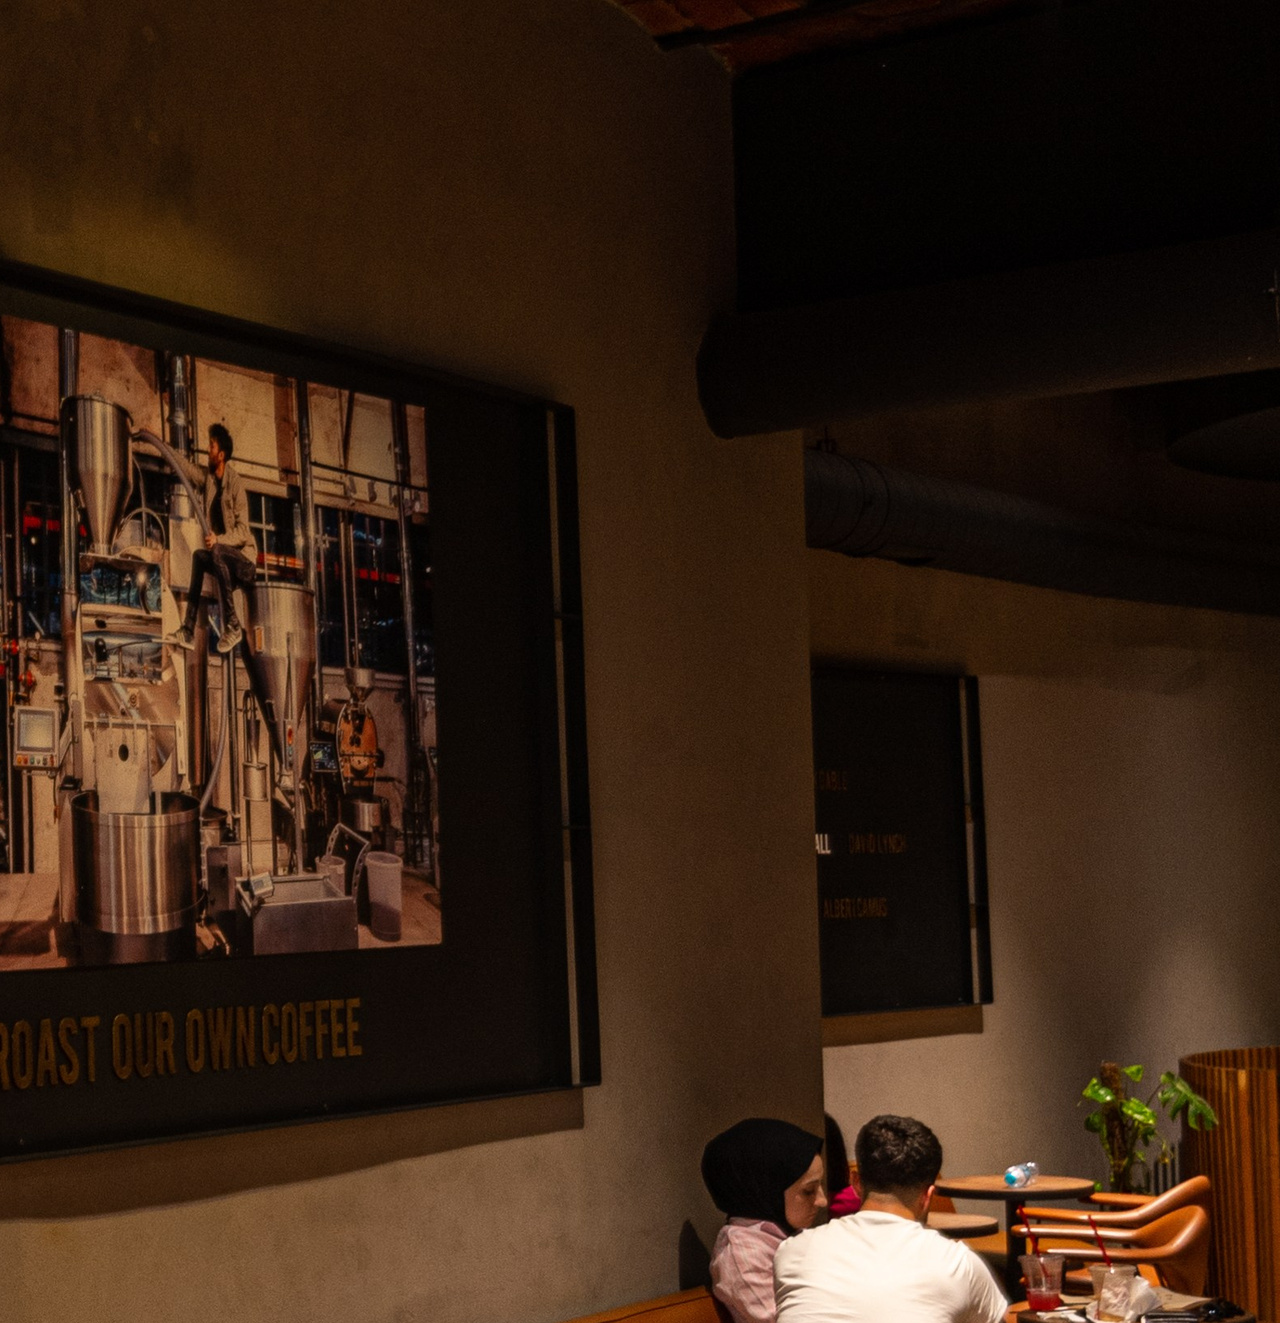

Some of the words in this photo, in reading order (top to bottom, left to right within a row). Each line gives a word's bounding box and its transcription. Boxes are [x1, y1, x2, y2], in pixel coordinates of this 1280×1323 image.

[111, 1008, 177, 1081] OUR
[185, 1004, 256, 1075] OWN
[261, 996, 363, 1066] COFFEE
